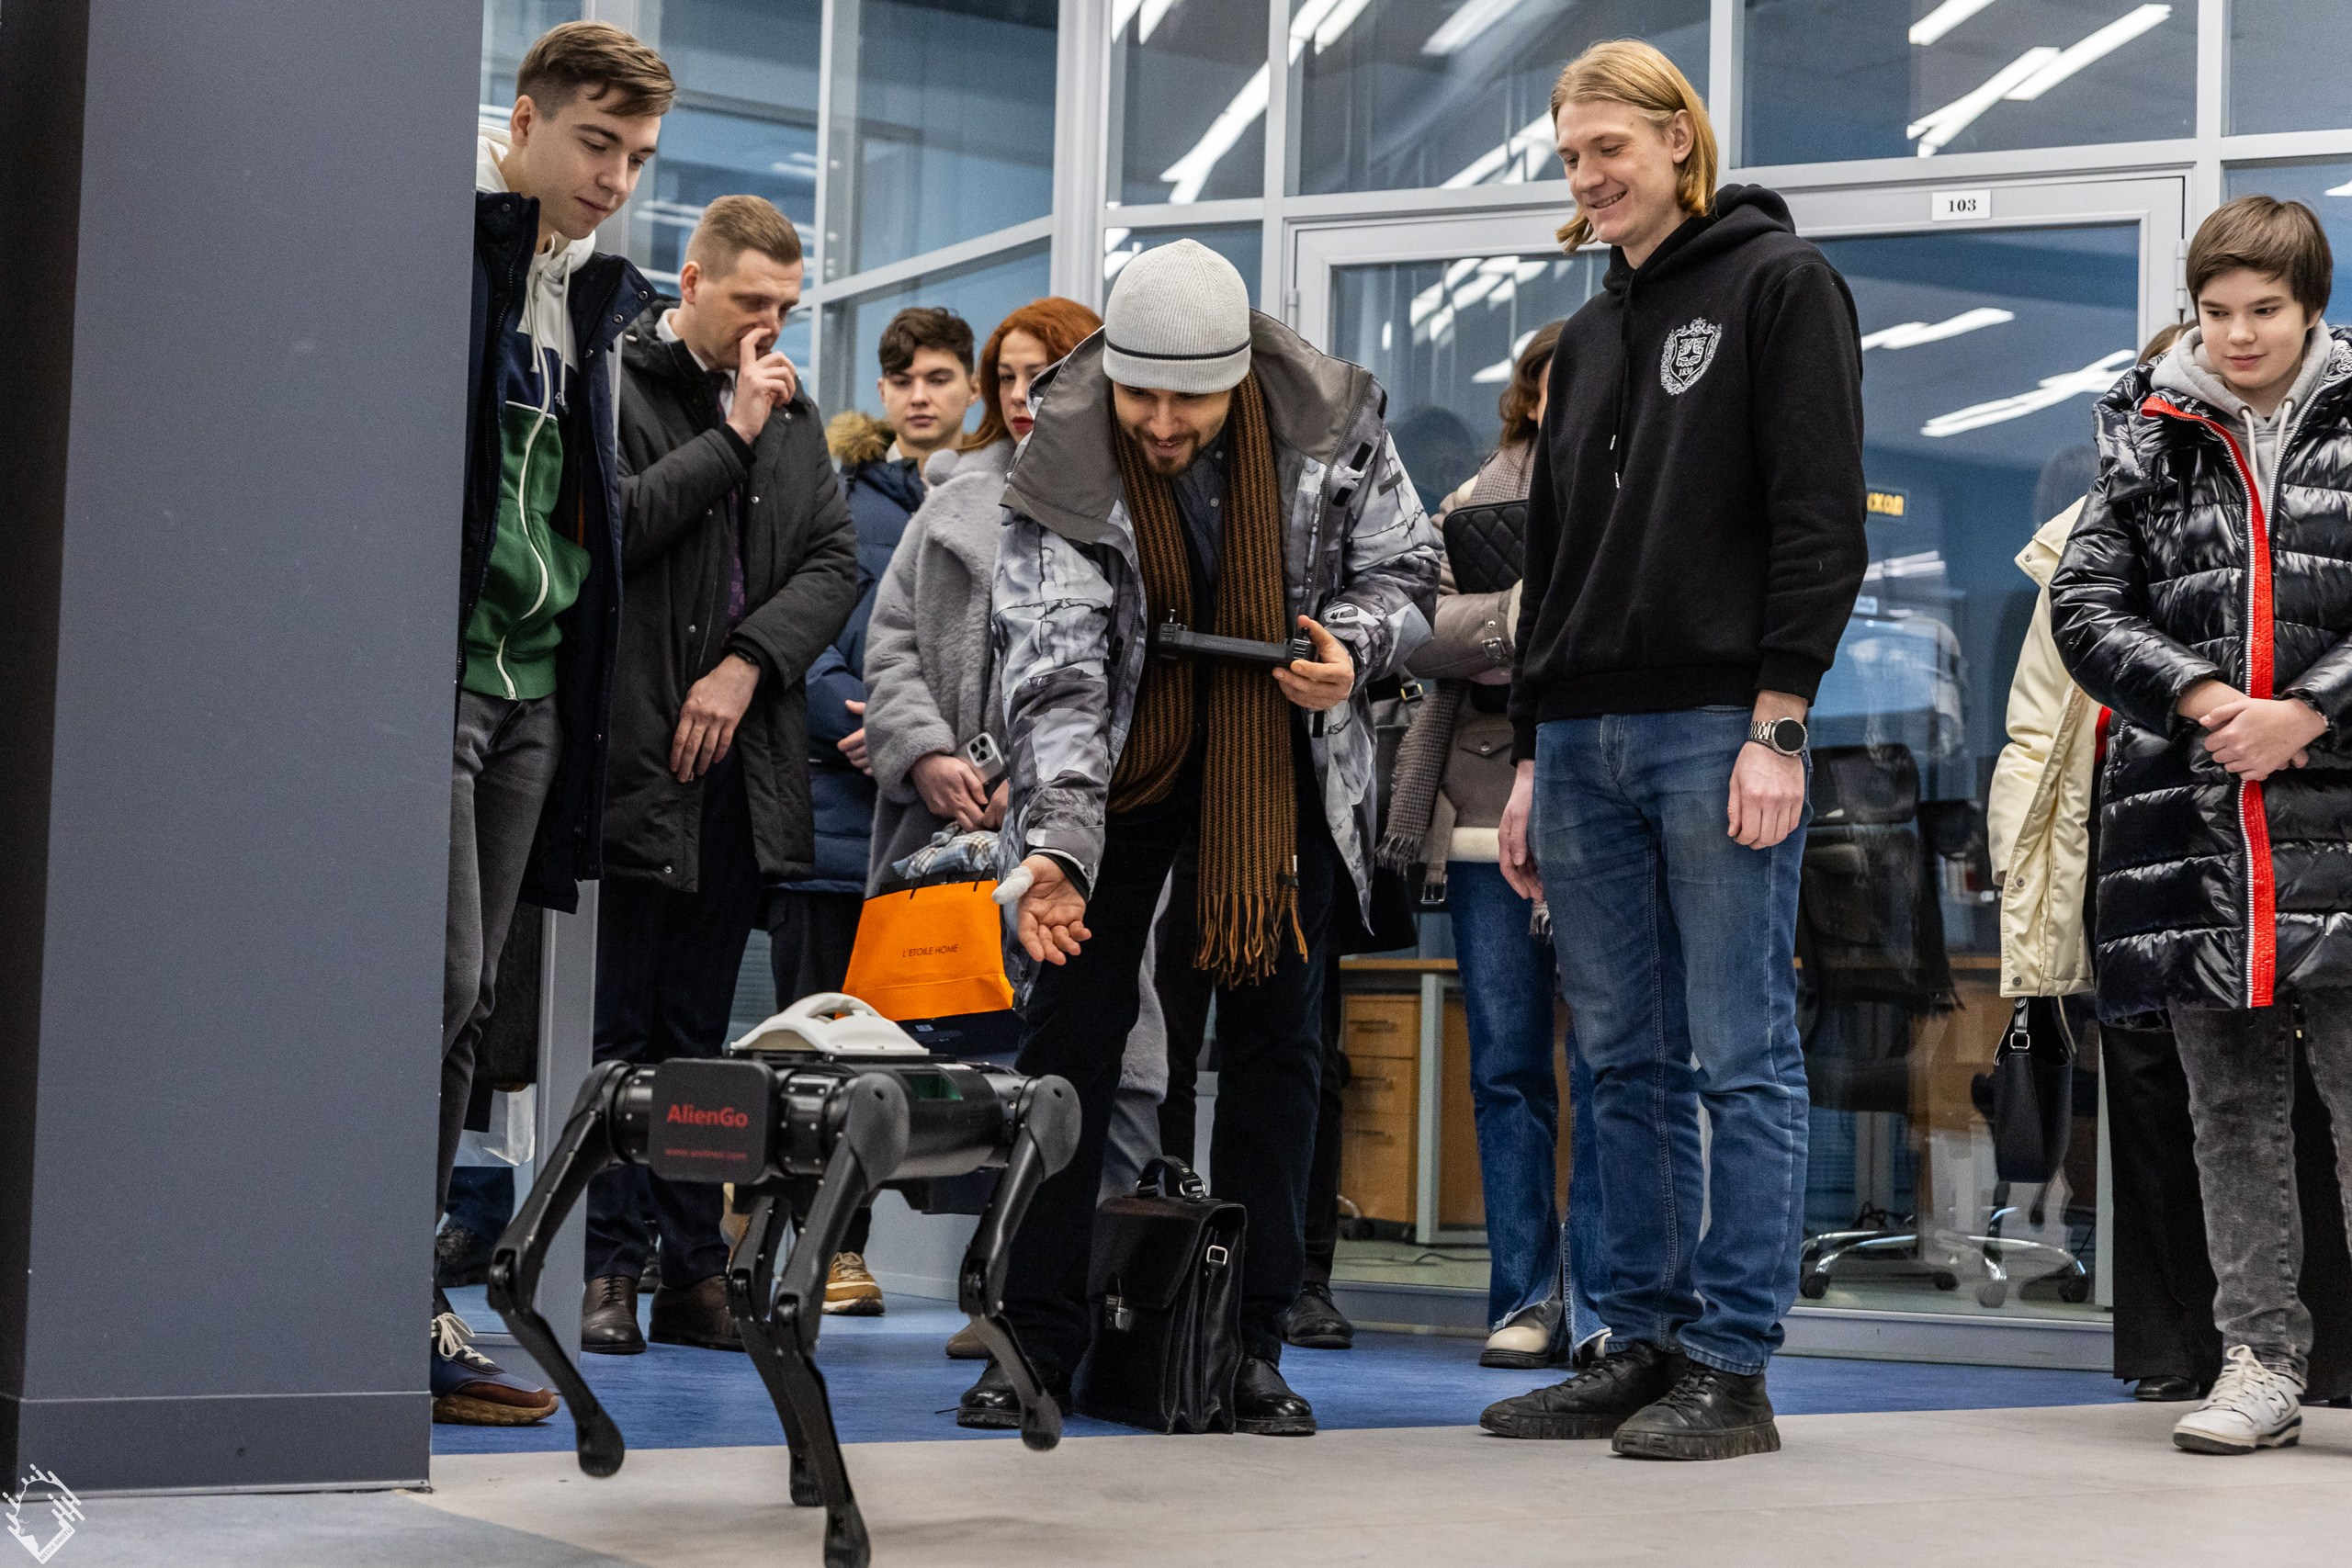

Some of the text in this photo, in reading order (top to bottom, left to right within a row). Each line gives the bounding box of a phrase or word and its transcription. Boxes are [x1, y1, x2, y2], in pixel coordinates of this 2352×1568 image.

[1949, 198, 1976, 212] 103
[935, 944, 958, 954] HOME
[667, 1104, 749, 1128] AlienGo
